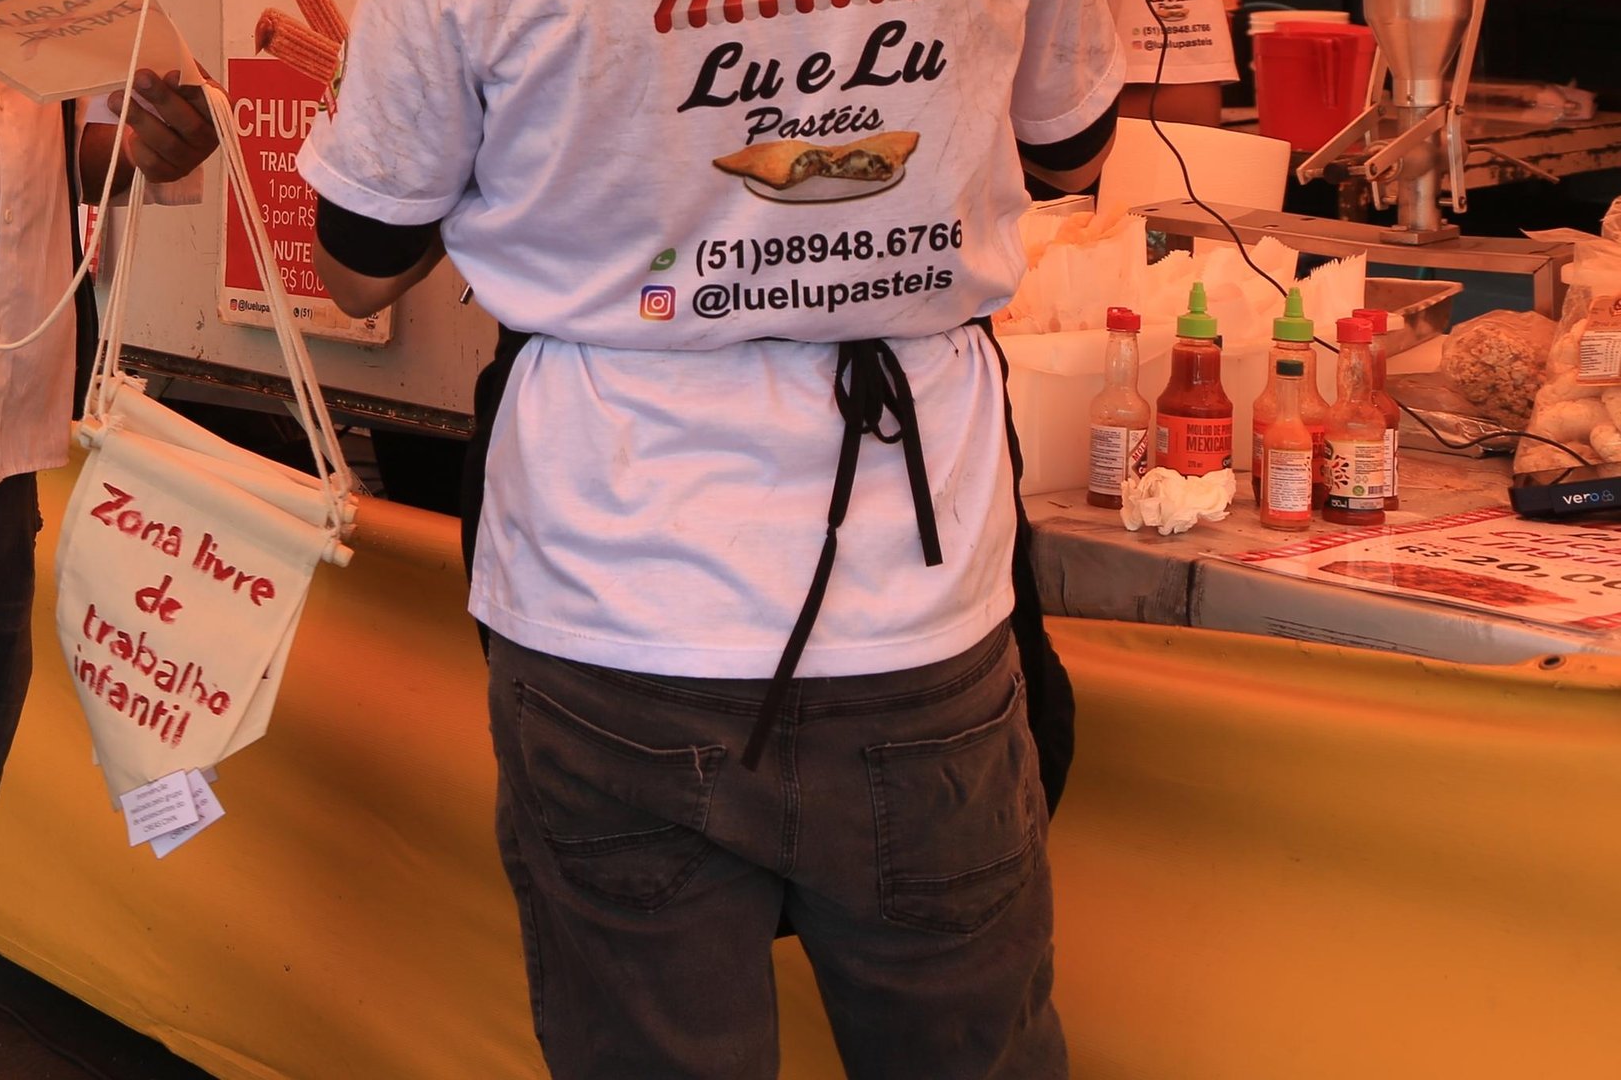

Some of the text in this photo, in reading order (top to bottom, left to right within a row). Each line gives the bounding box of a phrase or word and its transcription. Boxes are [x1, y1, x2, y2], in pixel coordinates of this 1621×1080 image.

[677, 20, 947, 113] Lu e Lu
[744, 105, 884, 146] Pastéis
[269, 178, 302, 204] 1 por
[261, 203, 316, 230] 3 por R$
[695, 219, 963, 278] (51)98948.6766
[281, 266, 297, 291] R$
[692, 265, 954, 320] @luelupasteis
[1186, 423, 1212, 436] MOLHO
[1213, 423, 1221, 436] DE
[1562, 492, 1600, 505] vero
[90, 482, 276, 607] Zona livre
[135, 575, 183, 623] de
[82, 603, 232, 717] trabalho
[73, 644, 191, 749] infantil
